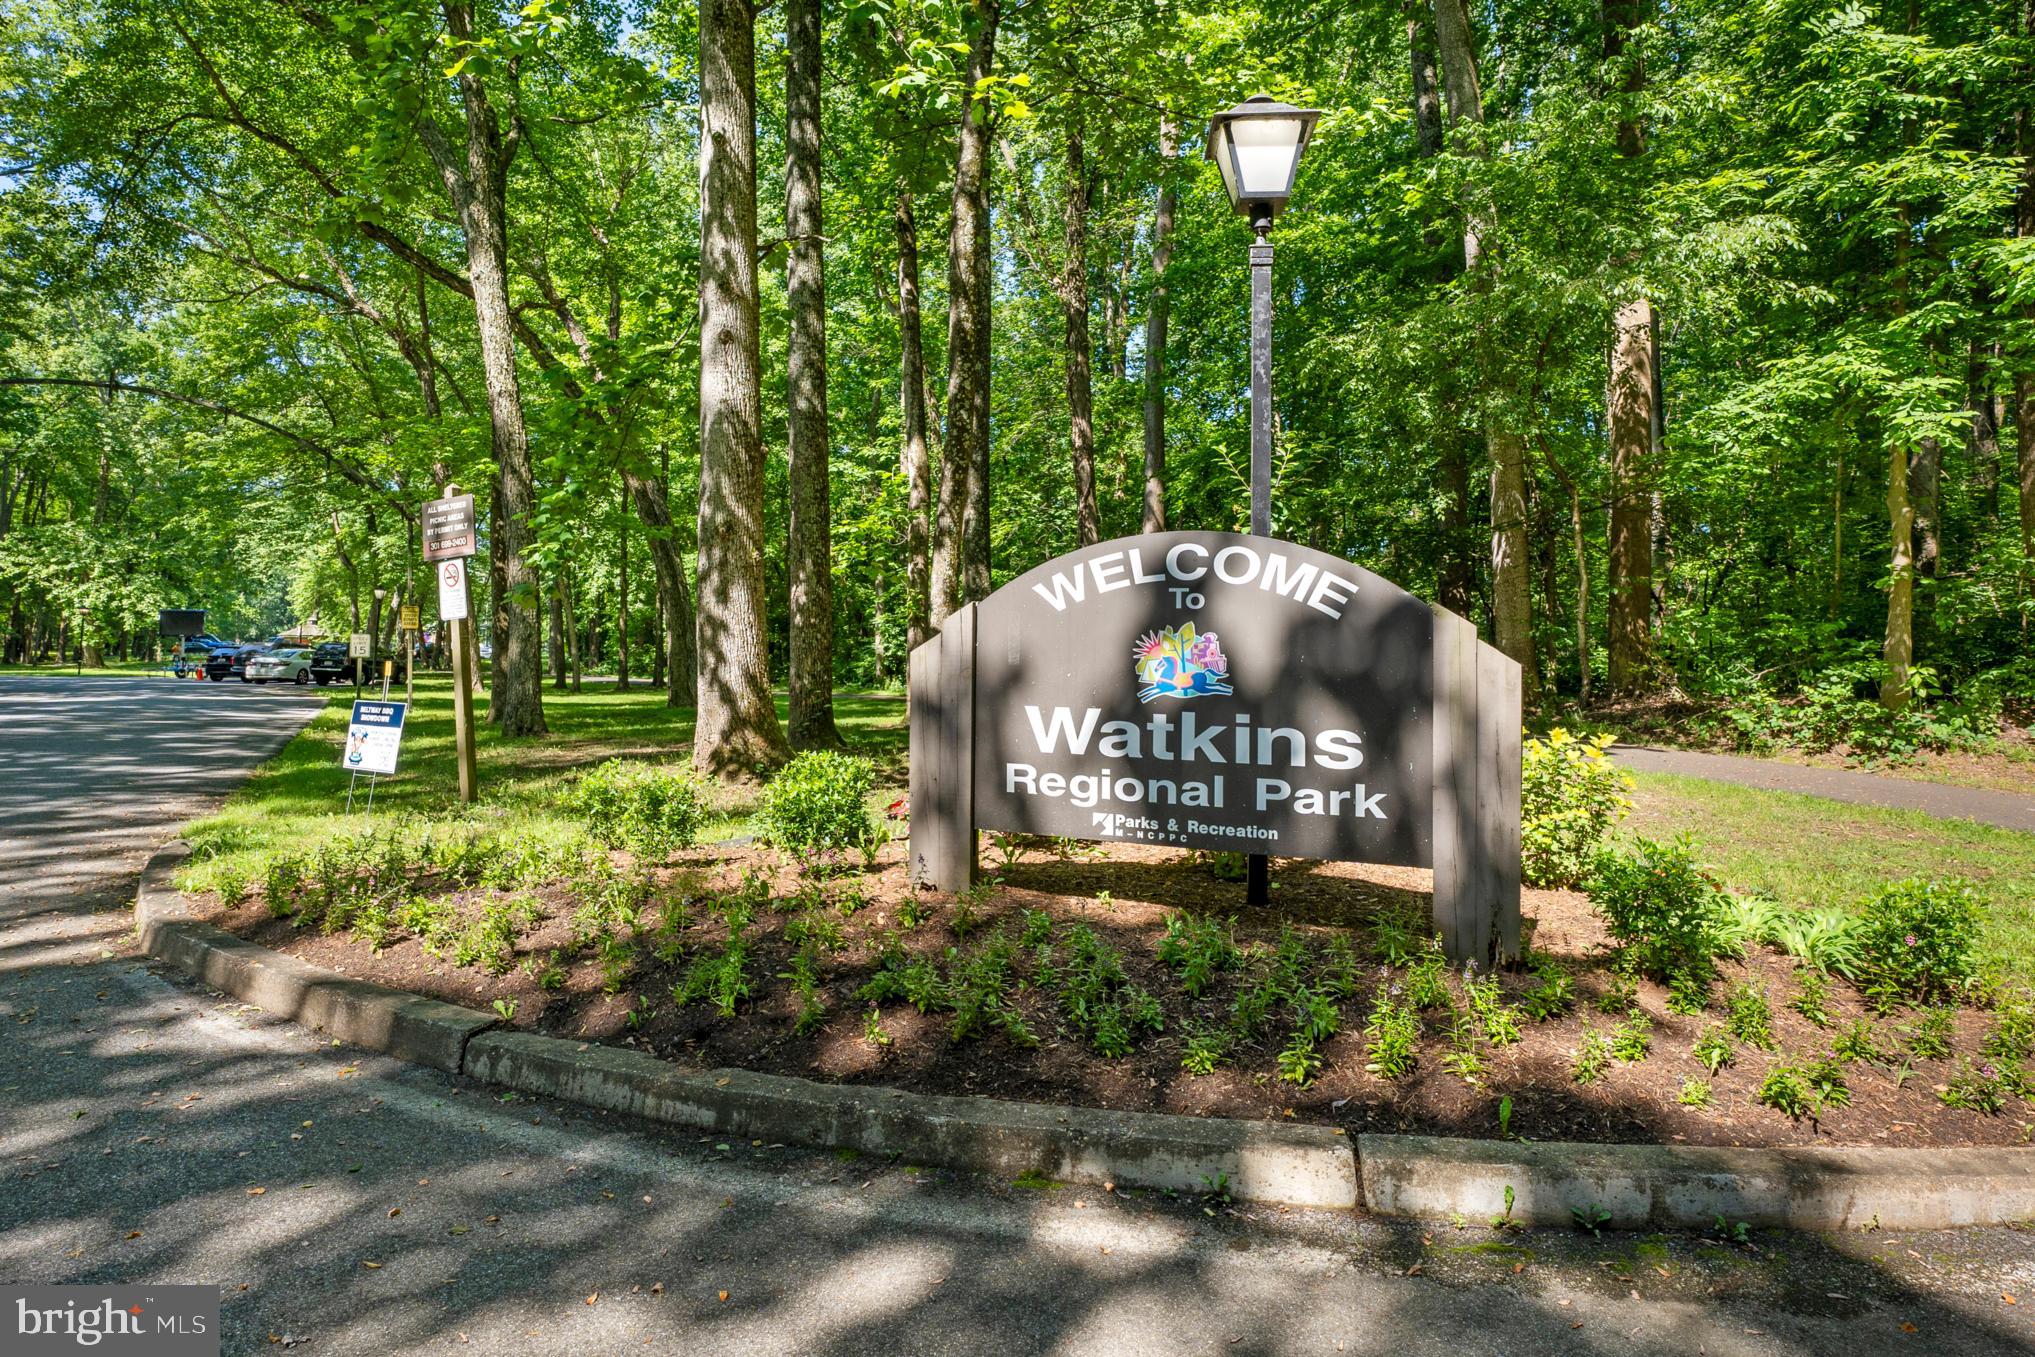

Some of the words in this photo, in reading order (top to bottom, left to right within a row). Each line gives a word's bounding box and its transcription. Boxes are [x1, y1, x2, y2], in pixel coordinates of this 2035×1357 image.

[427, 506, 437, 514] ALL
[430, 516, 447, 524] PICNIC
[447, 512, 464, 522] AREAS
[435, 525, 453, 535] PERMIT
[454, 522, 468, 531] ONLY
[430, 542, 440, 550] 301
[1032, 543, 1359, 620] WELCOME
[1168, 587, 1206, 610] To
[354, 646, 366, 655] 15
[1024, 705, 1365, 770] Watkins
[1006, 762, 1224, 808] Regional
[1256, 777, 1389, 819] Park
[1115, 814, 1159, 830] Parks
[1167, 818, 1179, 832] &
[1187, 819, 1279, 840] Recreation
